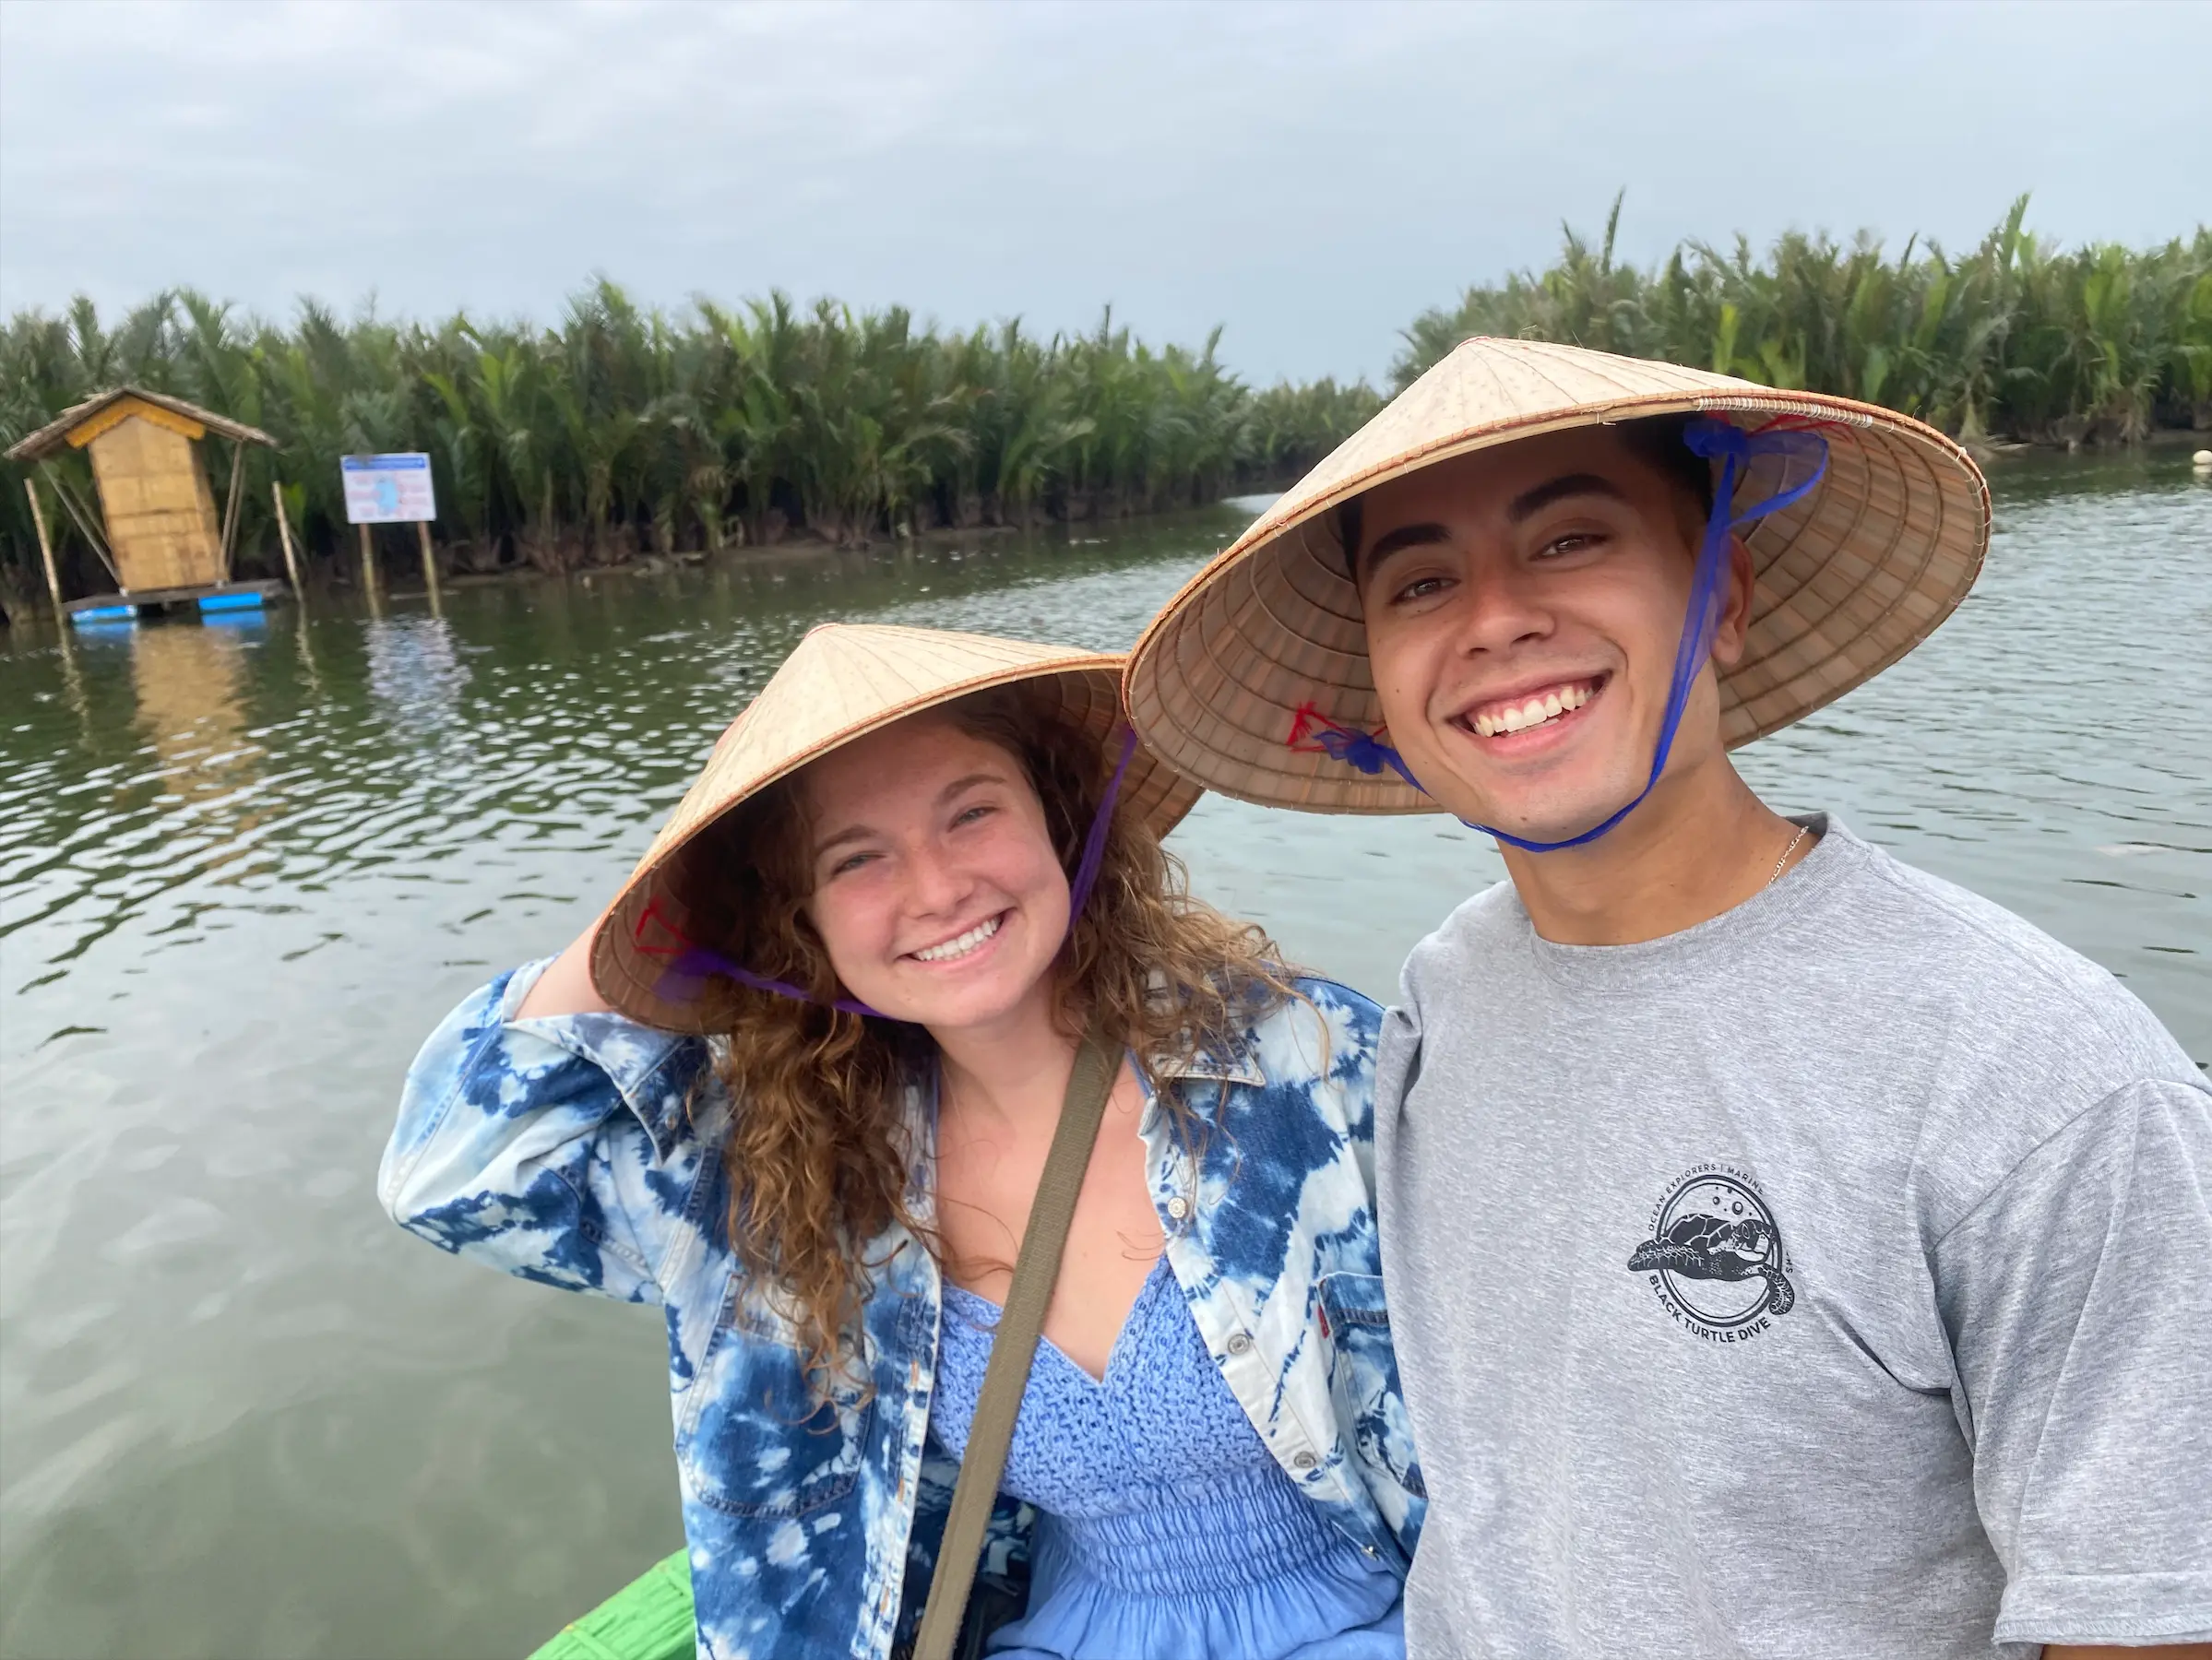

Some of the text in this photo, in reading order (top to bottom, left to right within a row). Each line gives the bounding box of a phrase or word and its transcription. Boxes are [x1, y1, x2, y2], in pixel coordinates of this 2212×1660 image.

[1648, 1163, 1764, 1231] OCEAN EXPLORERS MARINE
[1648, 1275, 1771, 1343] BLACK TURTLE DIVE
